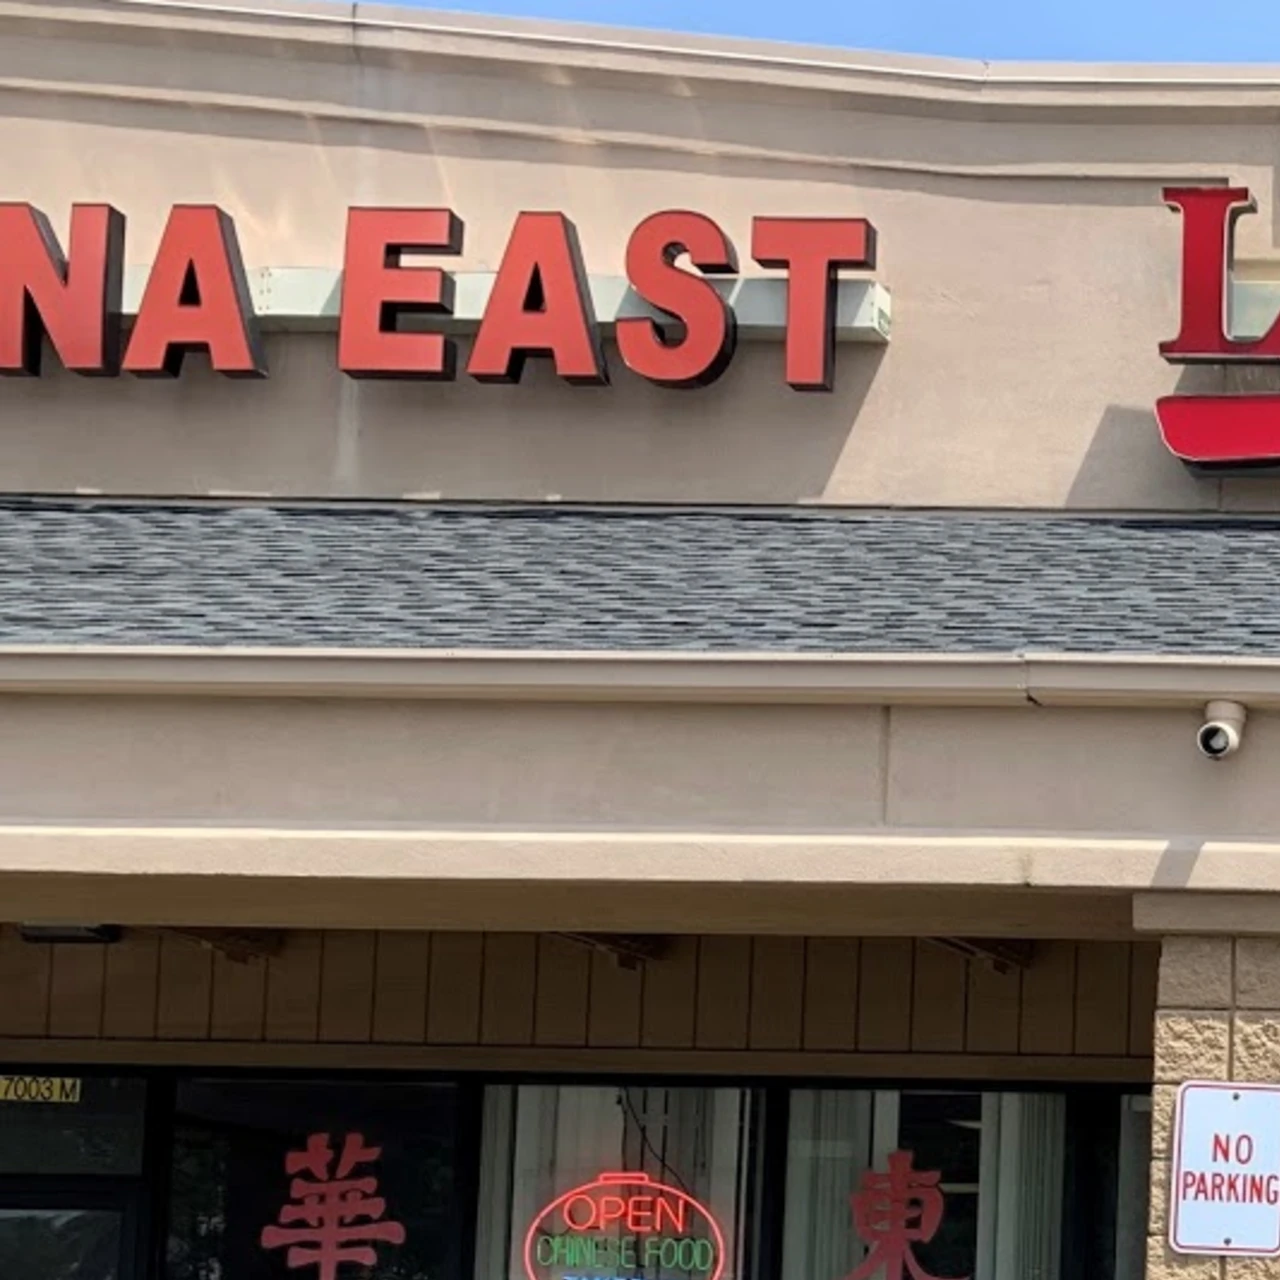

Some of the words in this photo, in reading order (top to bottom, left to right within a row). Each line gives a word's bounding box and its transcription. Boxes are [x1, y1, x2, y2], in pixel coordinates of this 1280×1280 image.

[0, 202, 268, 380] NA
[338, 206, 878, 392] EAST
[2, 1077, 54, 1101] 7003
[59, 1078, 77, 1101] M
[1212, 1132, 1254, 1165] NO
[1182, 1171, 1280, 1206] PARKING
[563, 1194, 685, 1233] OPEN
[536, 1235, 636, 1268] CHINESE
[644, 1237, 714, 1271] FOOD
